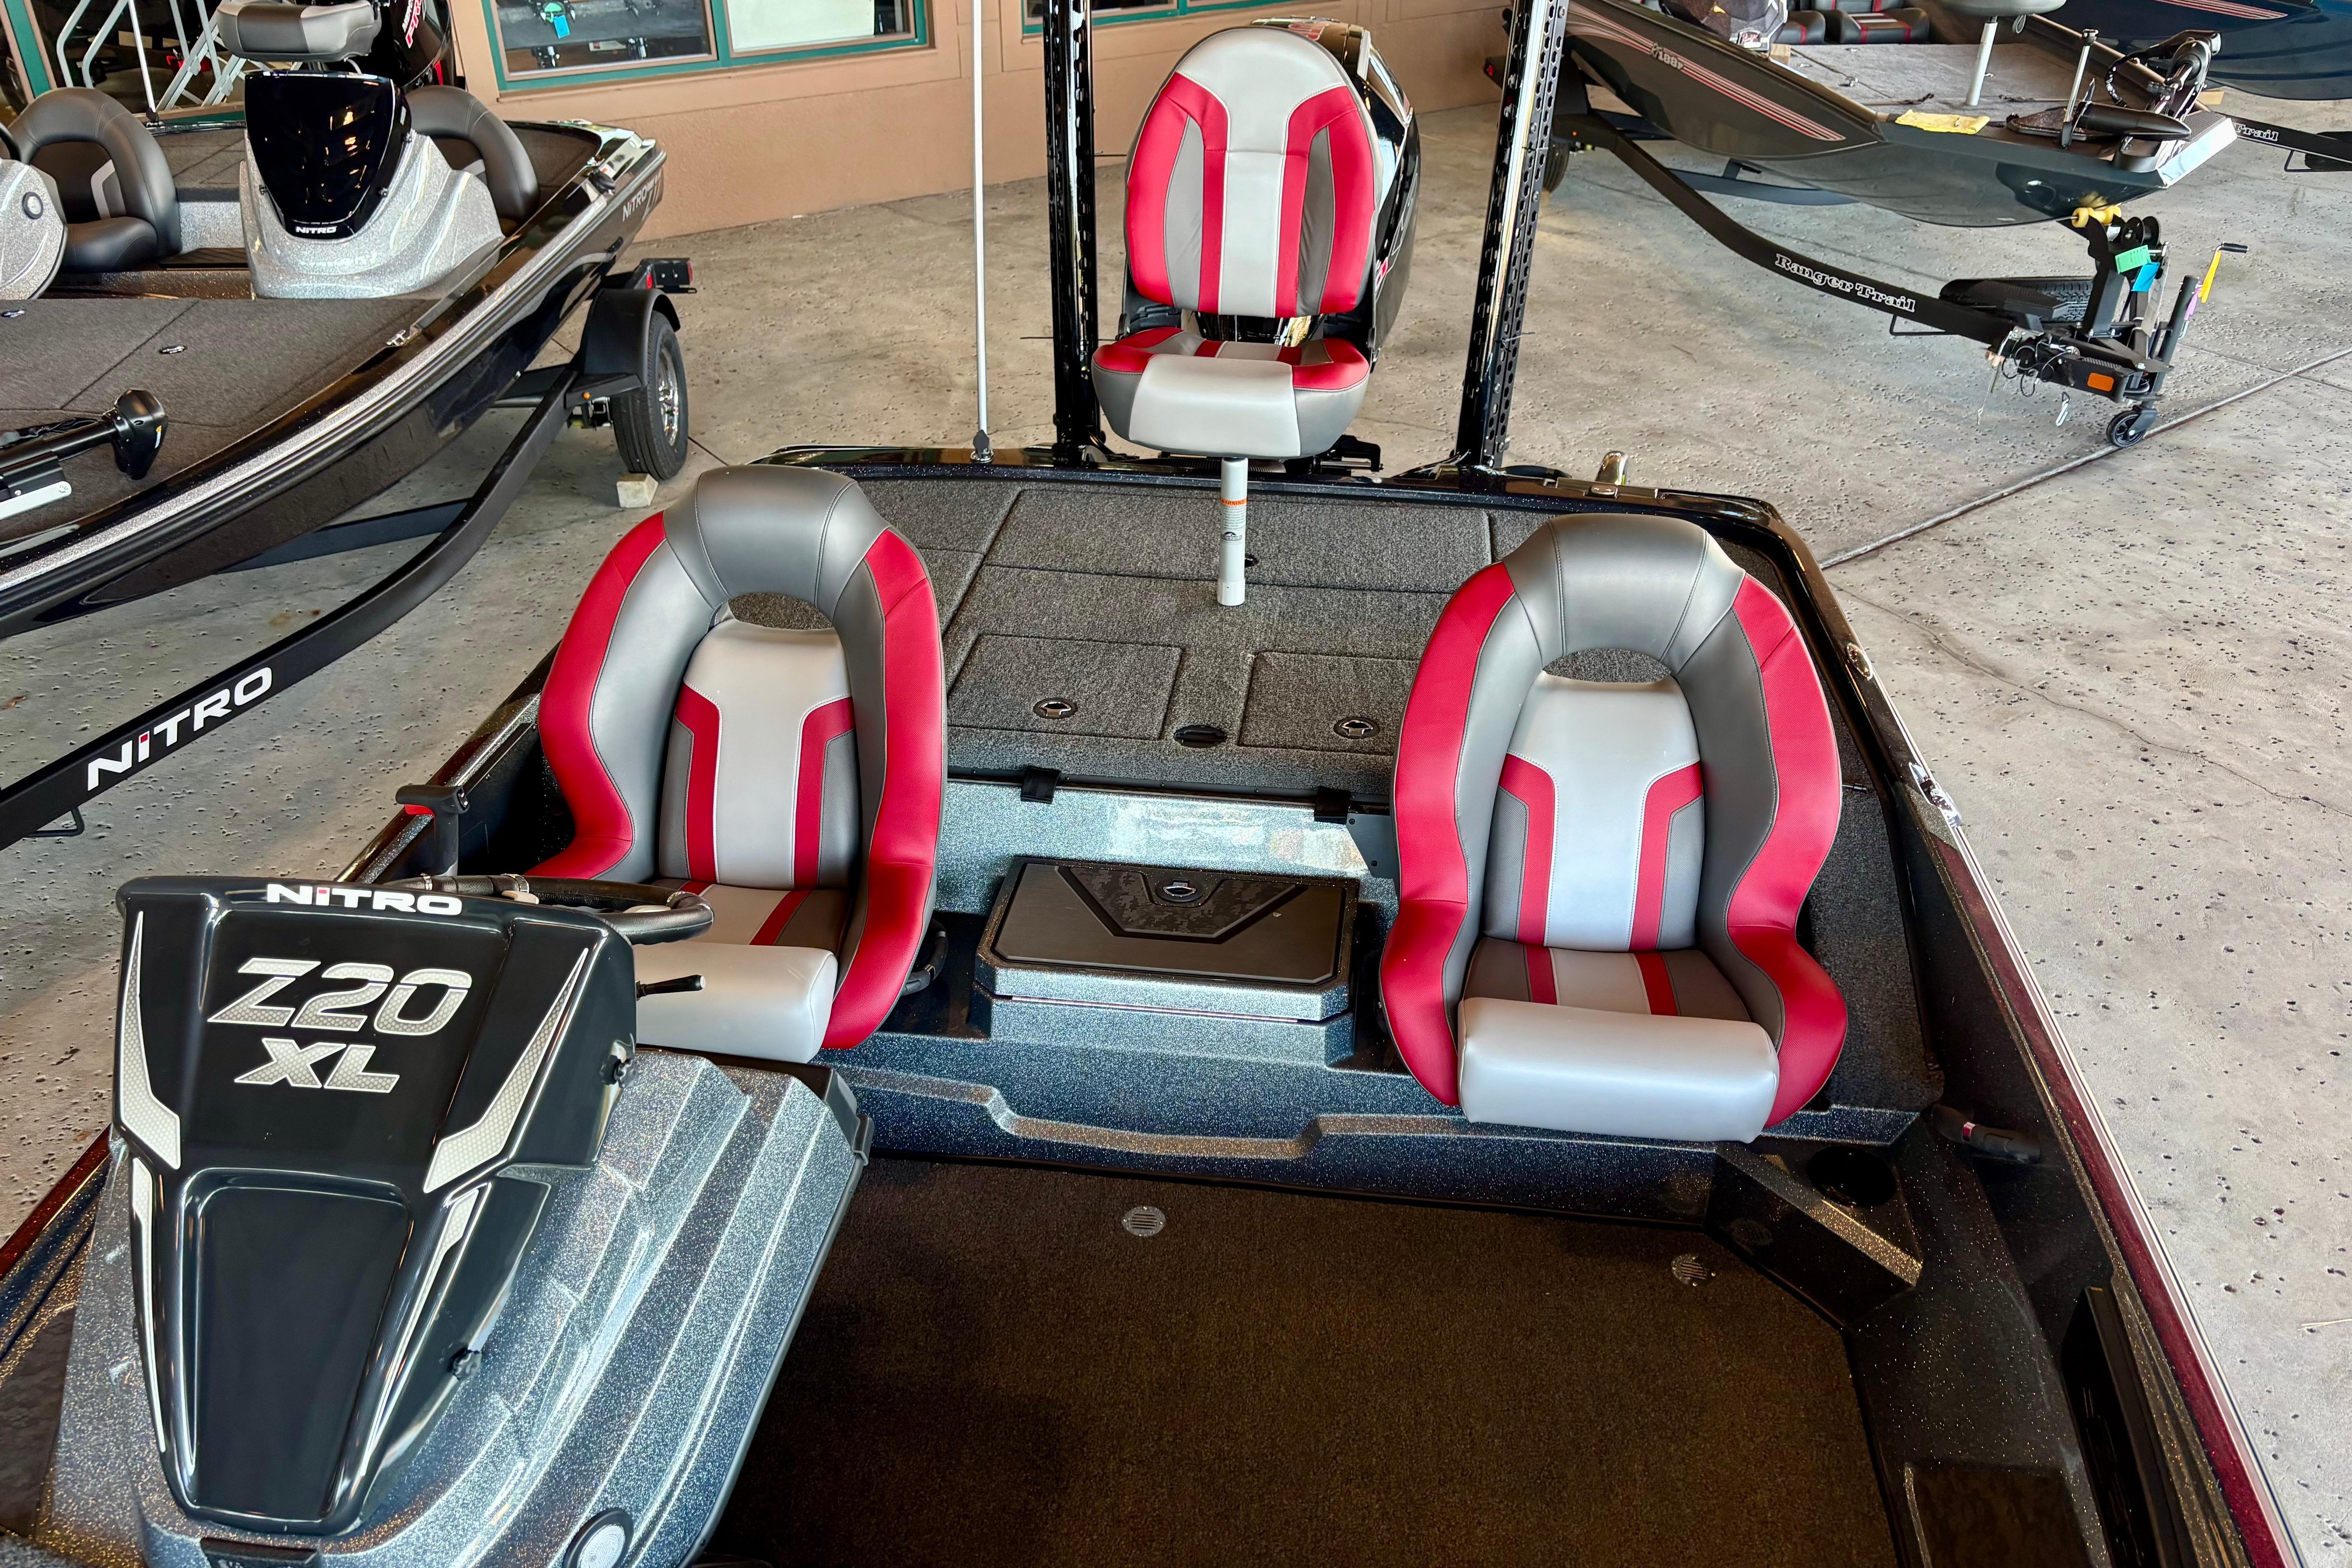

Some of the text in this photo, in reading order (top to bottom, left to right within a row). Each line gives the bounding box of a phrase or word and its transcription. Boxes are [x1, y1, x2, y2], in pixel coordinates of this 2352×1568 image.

[1775, 253, 1916, 312] Ranger Trail
[207, 957, 472, 1036] Z20
[234, 1038, 400, 1093] XL
